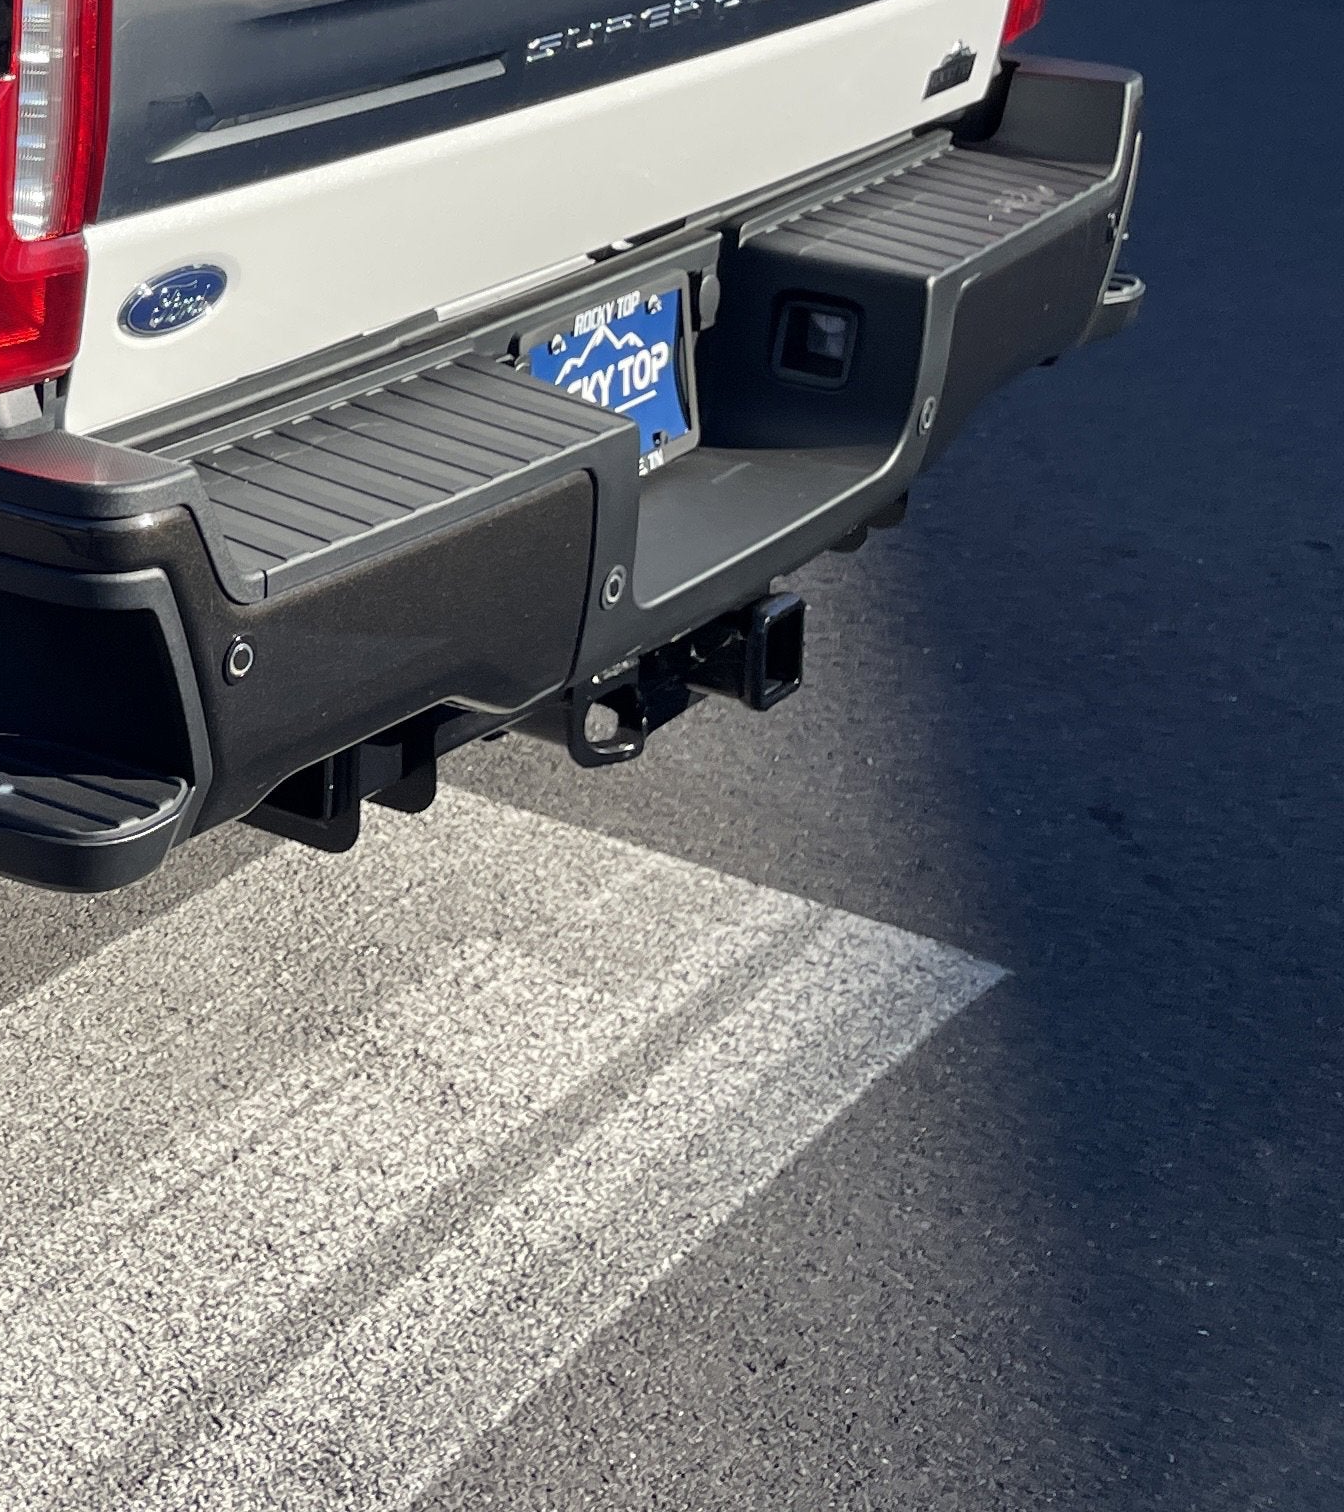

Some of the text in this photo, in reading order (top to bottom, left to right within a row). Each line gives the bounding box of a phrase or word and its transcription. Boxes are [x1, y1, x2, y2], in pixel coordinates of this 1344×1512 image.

[573, 290, 641, 337] ROCKY TOP
[617, 341, 669, 397] TOP
